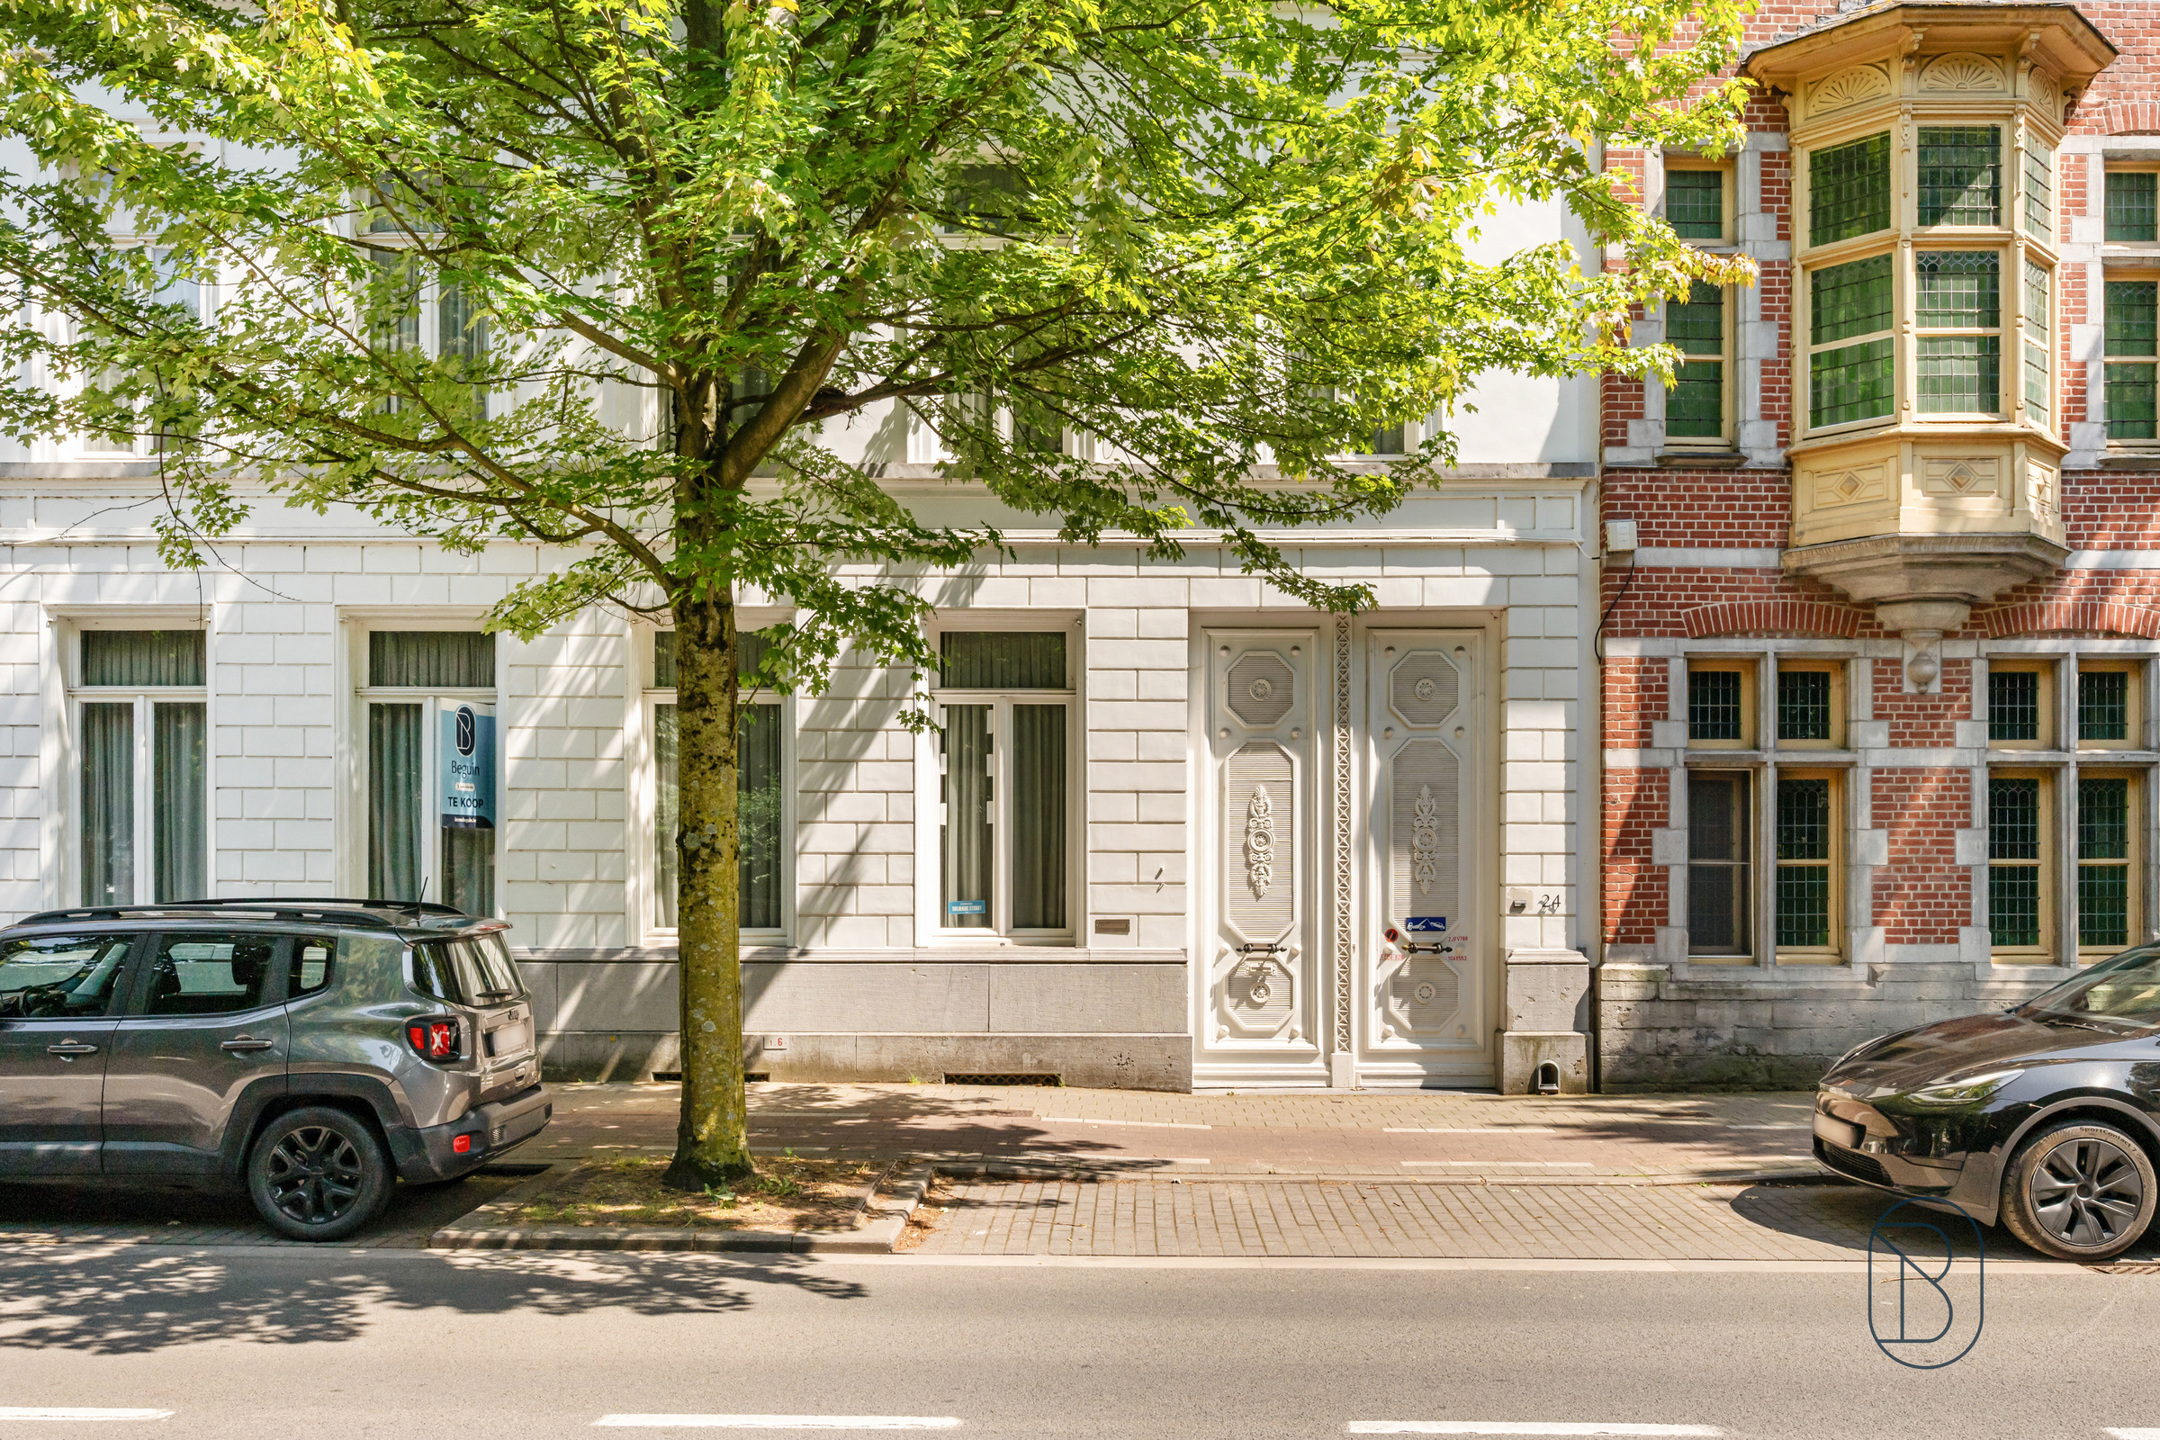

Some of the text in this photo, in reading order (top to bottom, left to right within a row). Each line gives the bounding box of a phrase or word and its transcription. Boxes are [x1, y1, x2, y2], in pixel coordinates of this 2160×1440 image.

[451, 760, 480, 779] Beguin
[448, 796, 484, 808] TE KOOP
[1541, 893, 1561, 908] 24
[777, 1037, 783, 1047] 6
[2080, 1126, 2131, 1148] SportContact
